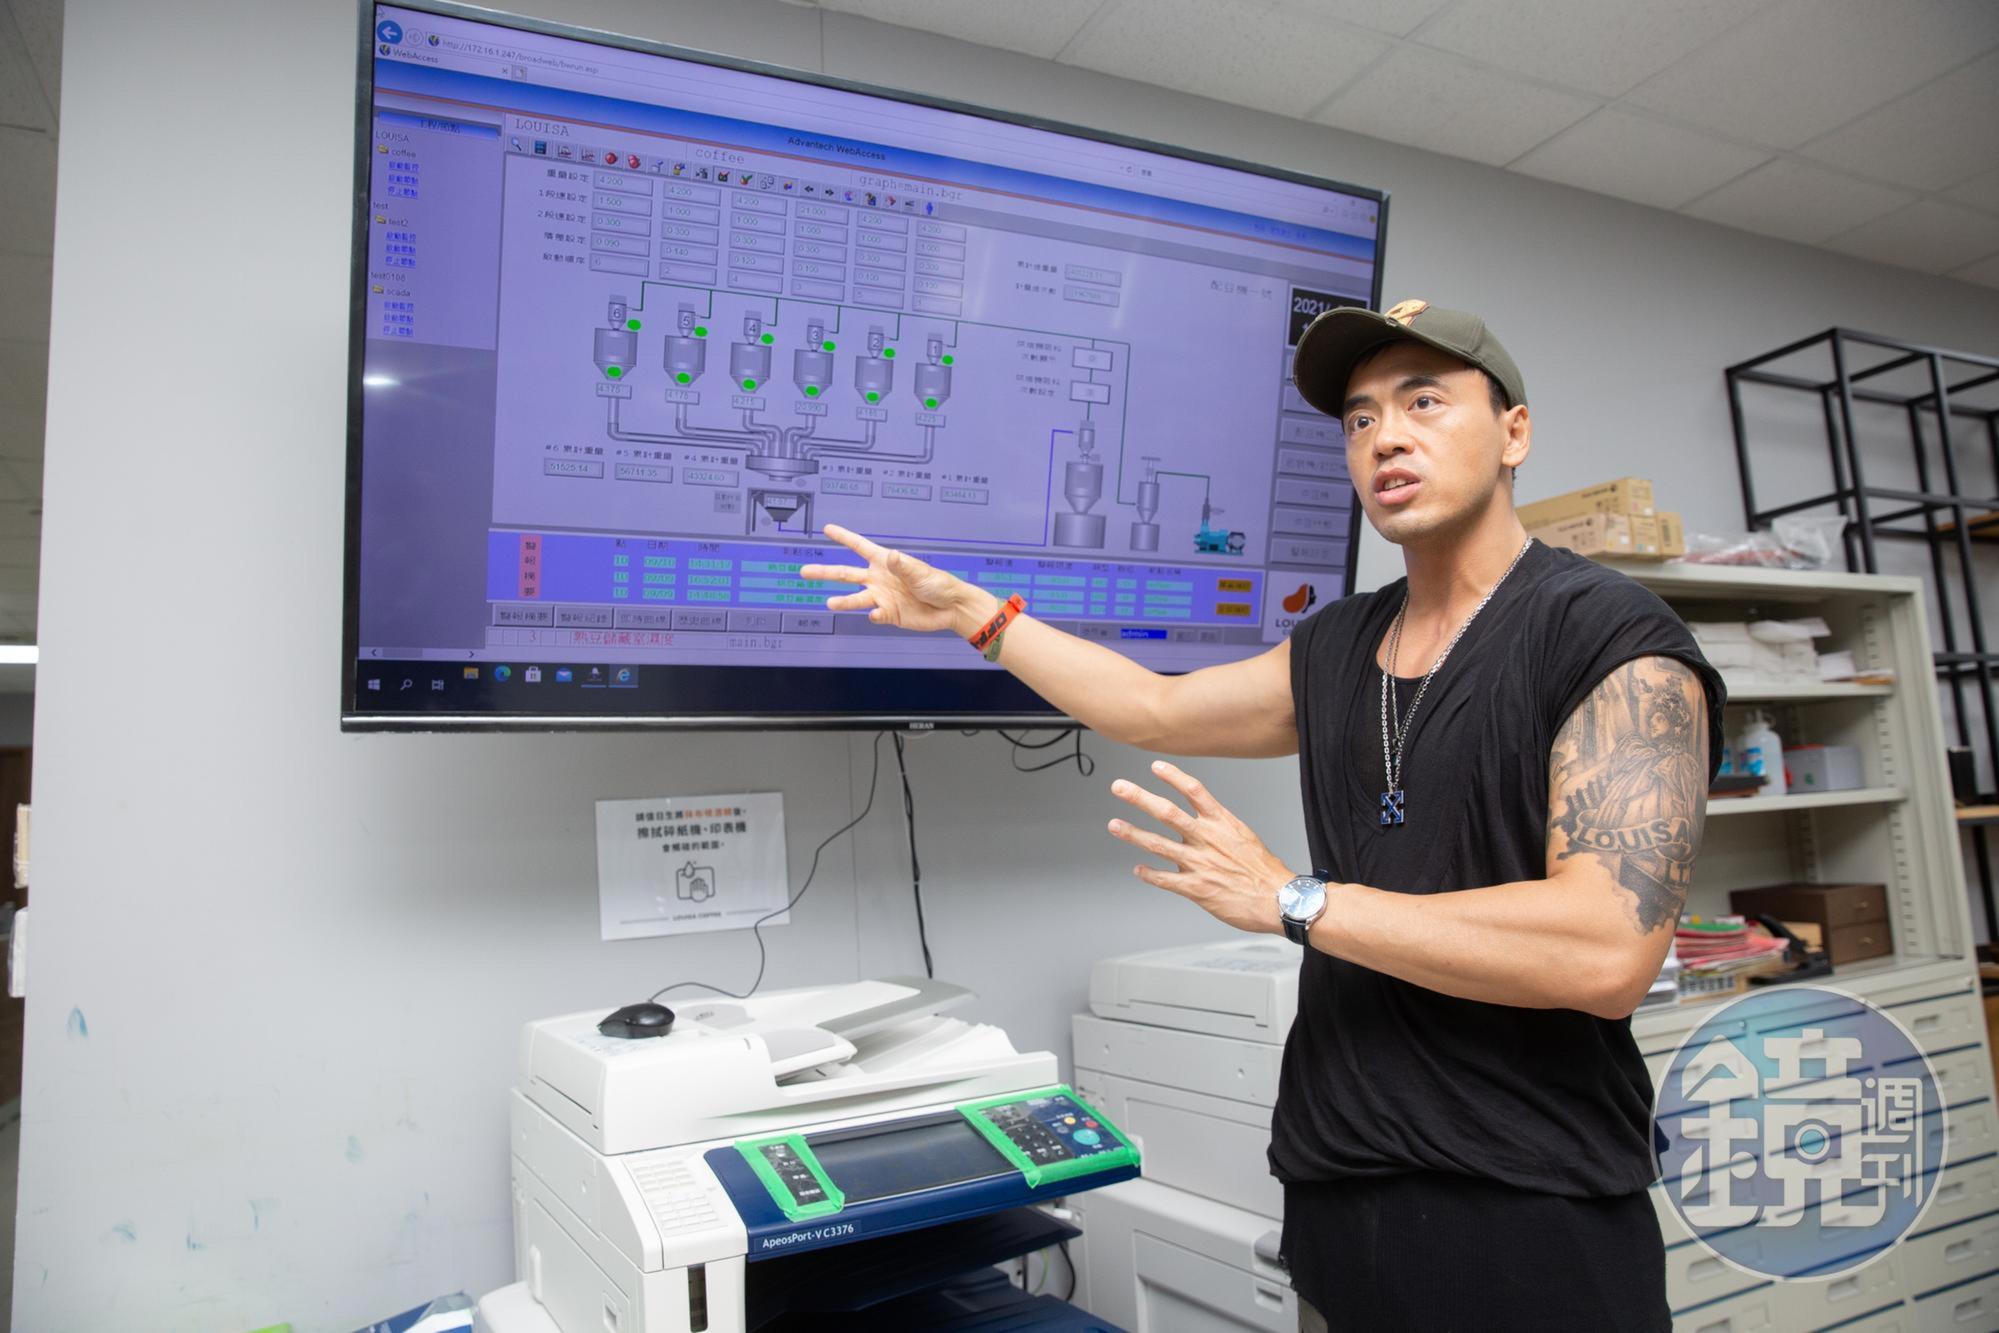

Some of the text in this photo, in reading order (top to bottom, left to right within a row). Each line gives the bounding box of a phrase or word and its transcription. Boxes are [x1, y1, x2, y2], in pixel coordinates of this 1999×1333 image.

[393, 48, 439, 63] WebAccess
[515, 118, 570, 137] LOUISA
[375, 130, 410, 143] LOUISA
[391, 148, 417, 158] coffee
[787, 136, 886, 161] Advantech WebAccess
[696, 147, 745, 165] coffee
[373, 201, 389, 210] test
[388, 218, 409, 228] test2
[386, 287, 411, 297] scada
[613, 308, 621, 318] 6
[682, 315, 690, 326] 5
[748, 323, 757, 334] 4
[811, 329, 819, 340] 3
[872, 337, 880, 349] 2
[1121, 630, 1149, 639] admin
[729, 635, 783, 649] main.bgr
[637, 821, 747, 838] 擦拭碎紙機、印表機
[1576, 818, 1690, 851] LOUISA
[762, 1223, 855, 1249] ApeosPort-V C3376
